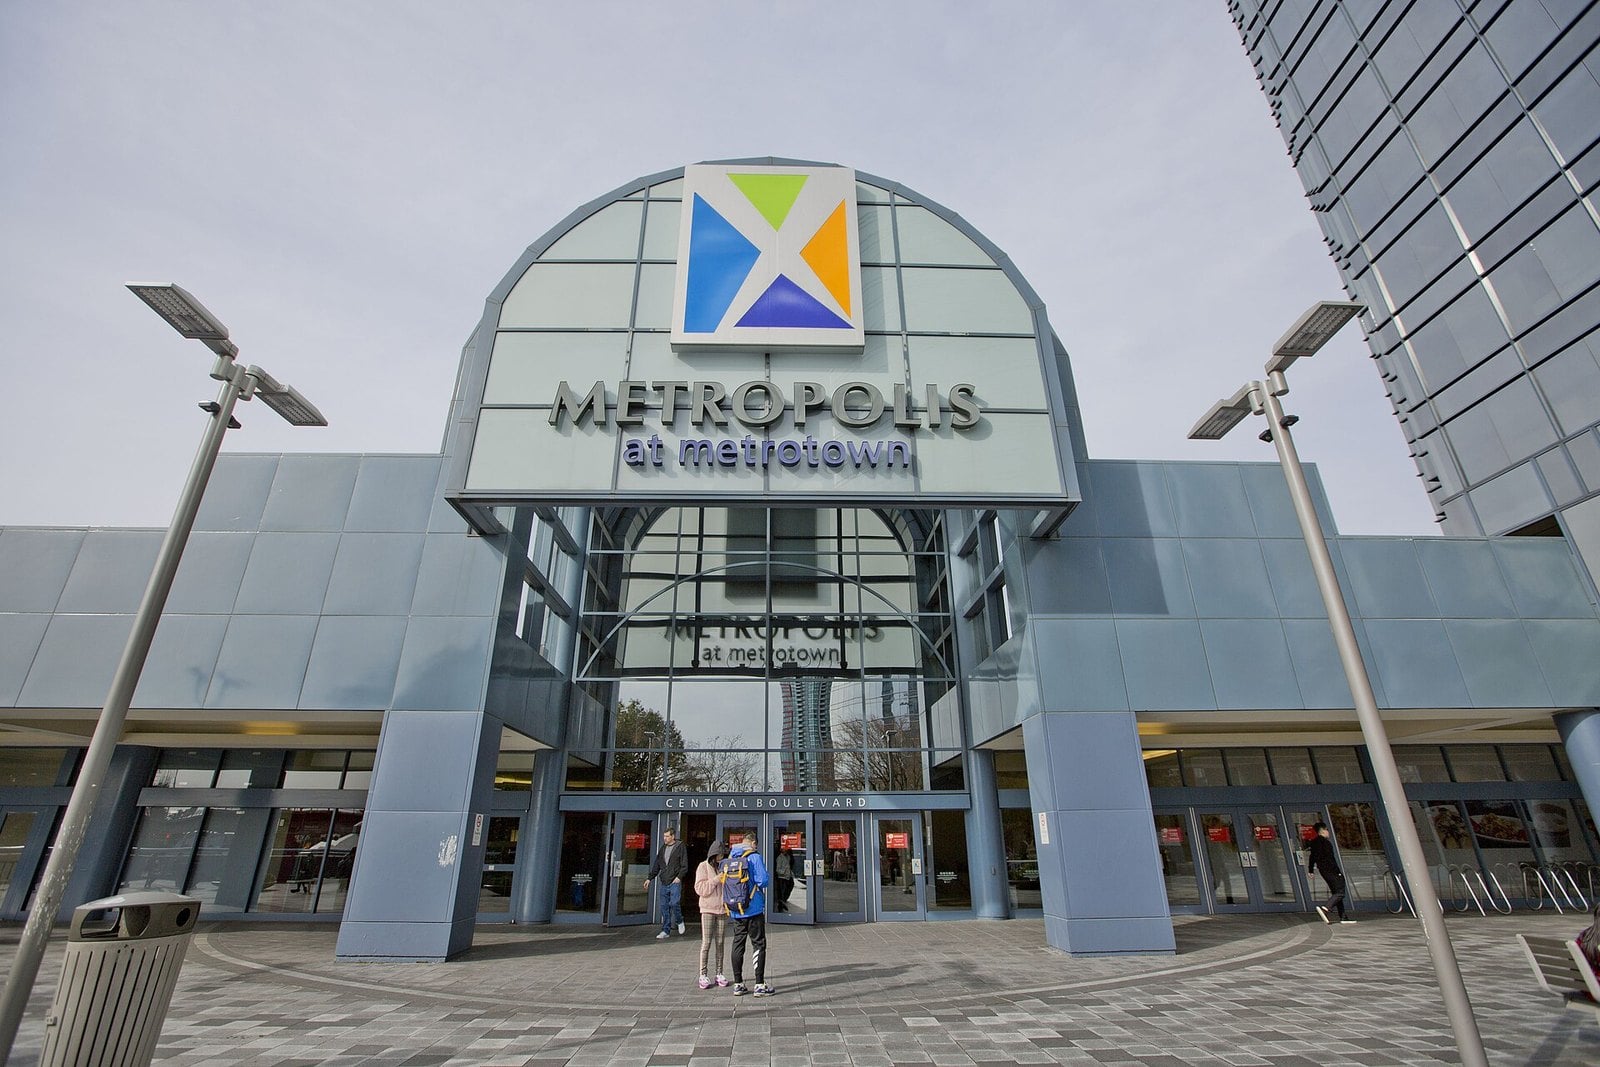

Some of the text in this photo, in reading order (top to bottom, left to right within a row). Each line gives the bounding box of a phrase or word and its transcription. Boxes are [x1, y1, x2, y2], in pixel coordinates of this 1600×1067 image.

[548, 380, 981, 430] METROPOLIS
[622, 433, 910, 468] at metrotown
[702, 645, 721, 662] at
[665, 797, 866, 808] CENTRAL BOULEVARD
